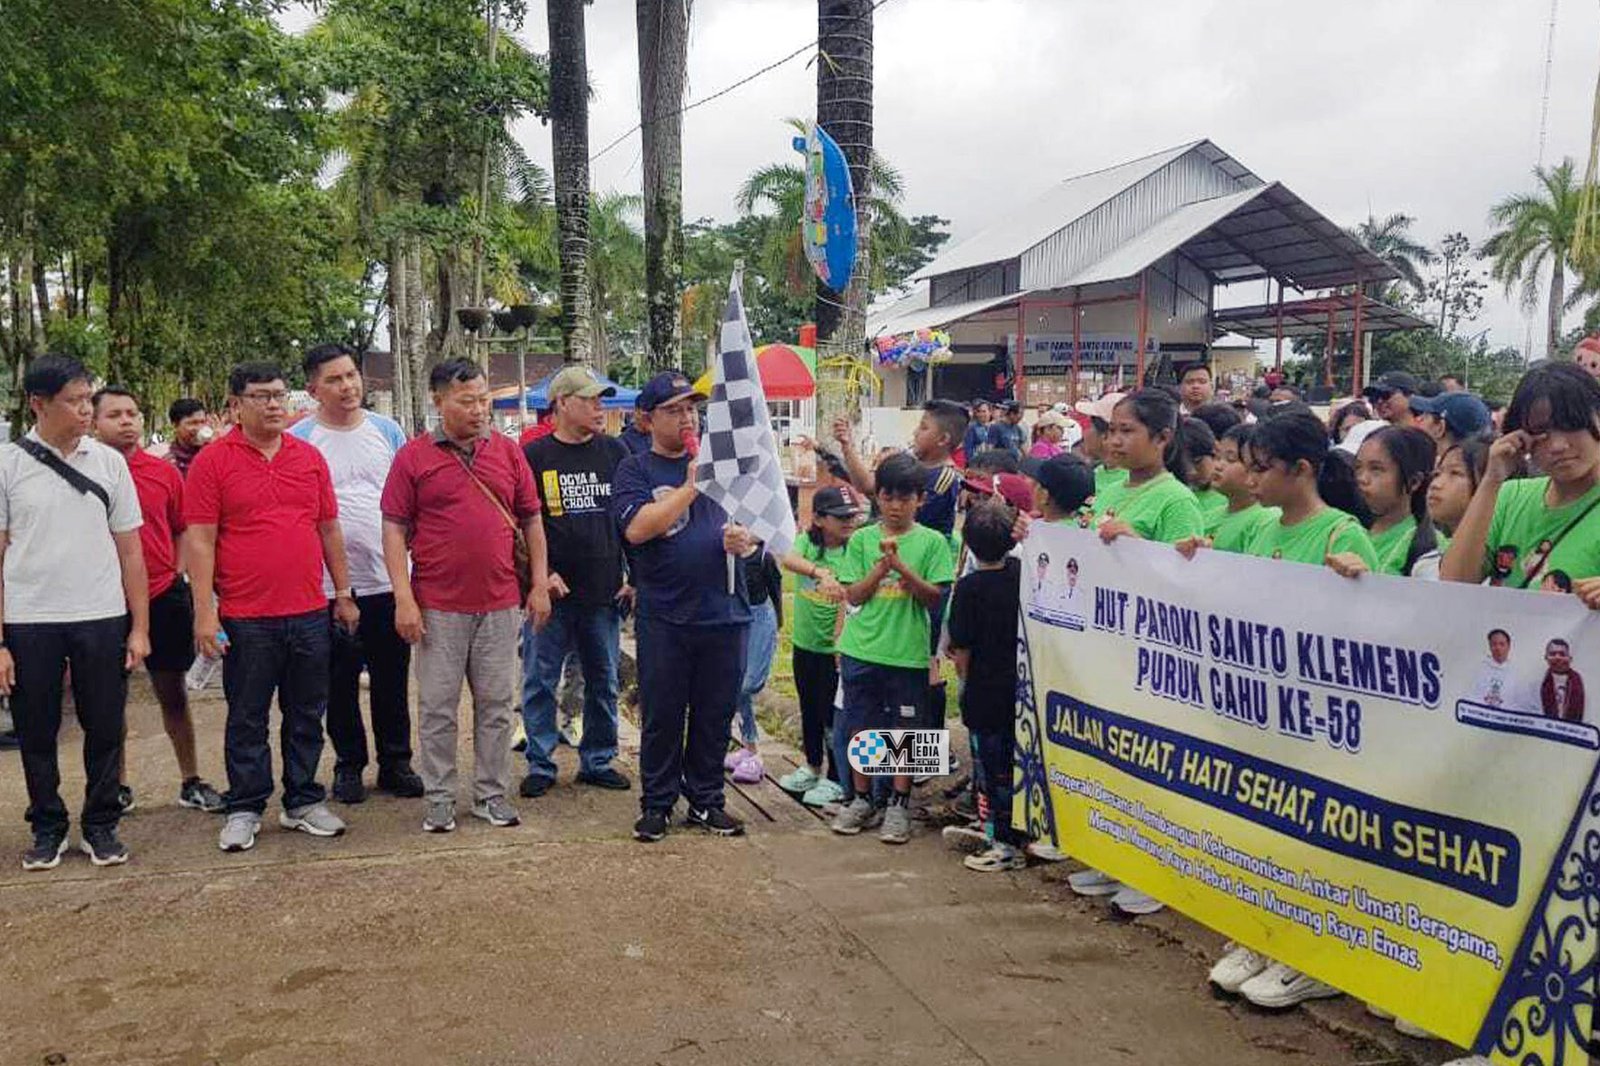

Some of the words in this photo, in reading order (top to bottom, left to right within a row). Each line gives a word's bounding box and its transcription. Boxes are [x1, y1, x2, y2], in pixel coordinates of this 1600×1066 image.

[561, 483, 612, 499] XECUTIVE
[1094, 586, 1128, 632] HUT
[1134, 595, 1203, 655] PAROKI
[1208, 614, 1288, 676] SANTO
[1297, 631, 1441, 707] KLEMENS
[1135, 647, 1204, 708] PURUK
[1209, 667, 1268, 729] CAHU
[1278, 685, 1361, 752] KE-58
[1052, 704, 1104, 750] JALAN
[1107, 725, 1176, 781] SEHAT,
[1180, 749, 1233, 796] HATI
[1236, 767, 1317, 834] SEHAT,
[1322, 797, 1382, 850] ROH
[1392, 819, 1507, 886] SEHAT
[1200, 830, 1298, 889] Keharmonisan
[1301, 869, 1350, 907] Antar
[1353, 885, 1403, 926] Umat
[1406, 902, 1504, 970] Beragama,
[1235, 877, 1261, 907] dan
[1262, 888, 1323, 929] Murung
[1324, 910, 1368, 949] Raya
[1371, 925, 1423, 971] Emas.
